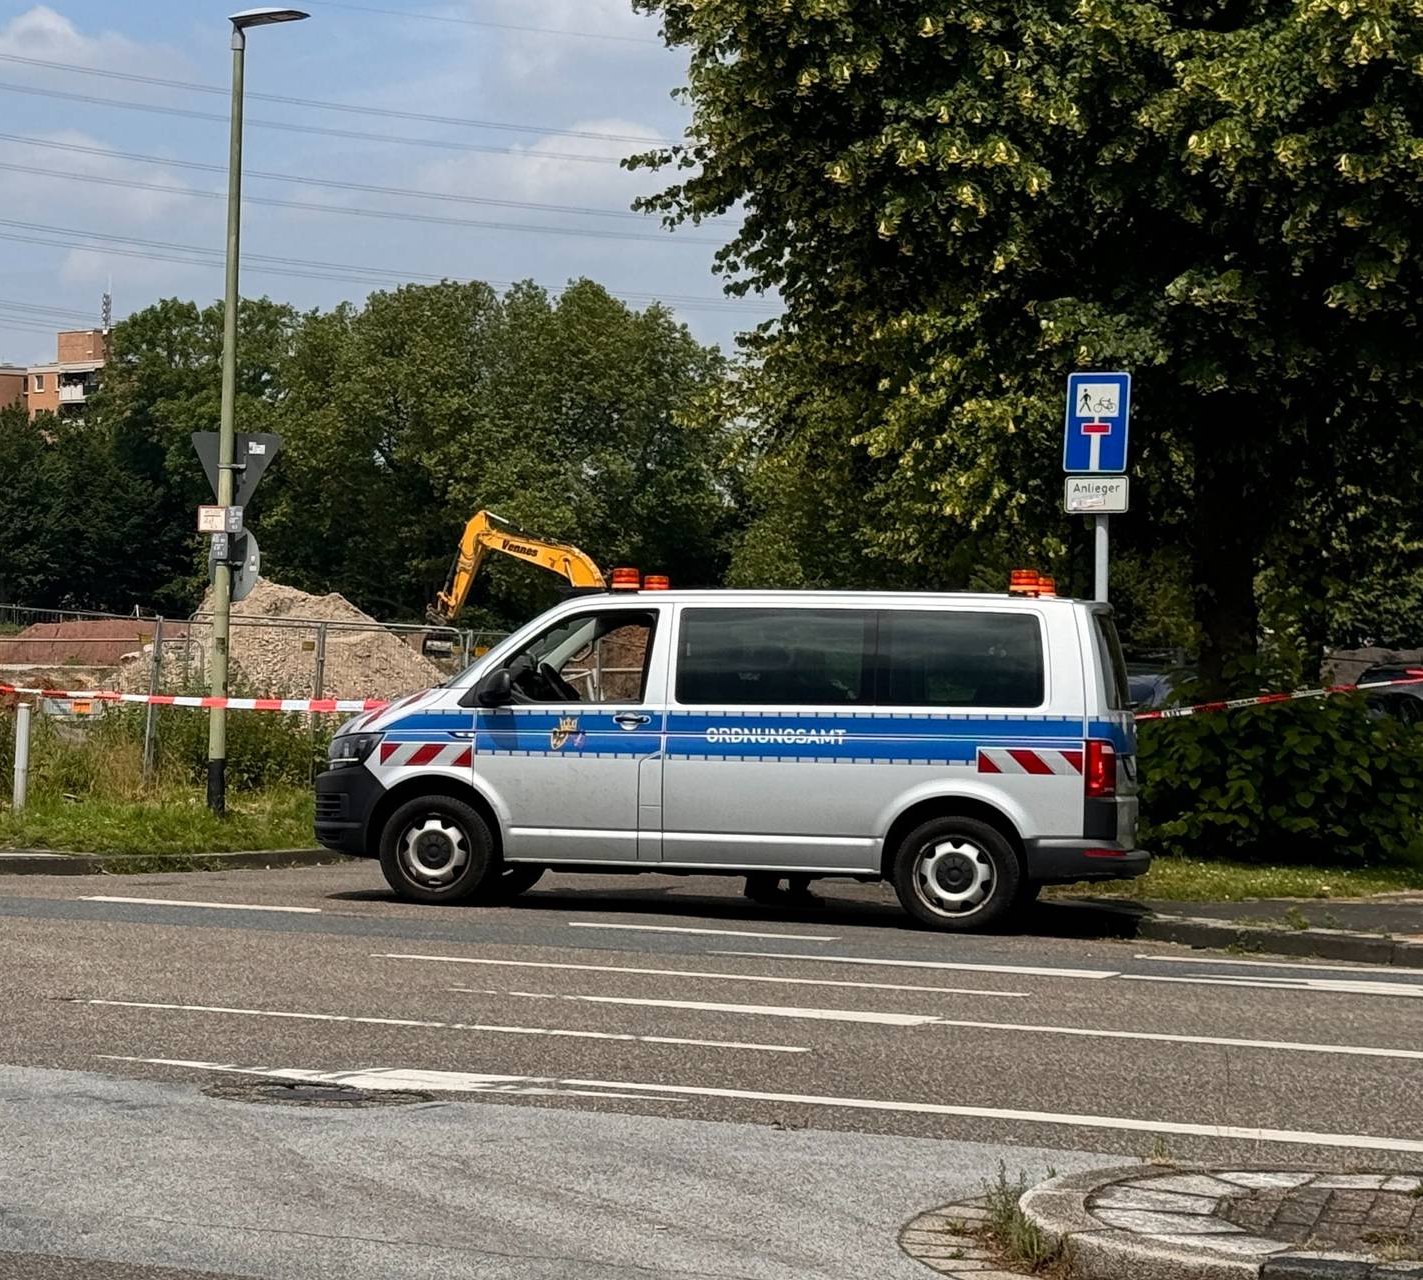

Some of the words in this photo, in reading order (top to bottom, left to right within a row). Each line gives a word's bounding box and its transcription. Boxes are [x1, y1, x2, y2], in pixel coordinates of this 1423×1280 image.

[1073, 483, 1120, 496] Anlieger
[502, 539, 538, 557] Vennes
[706, 727, 847, 745] ORDNUNGSAMT
